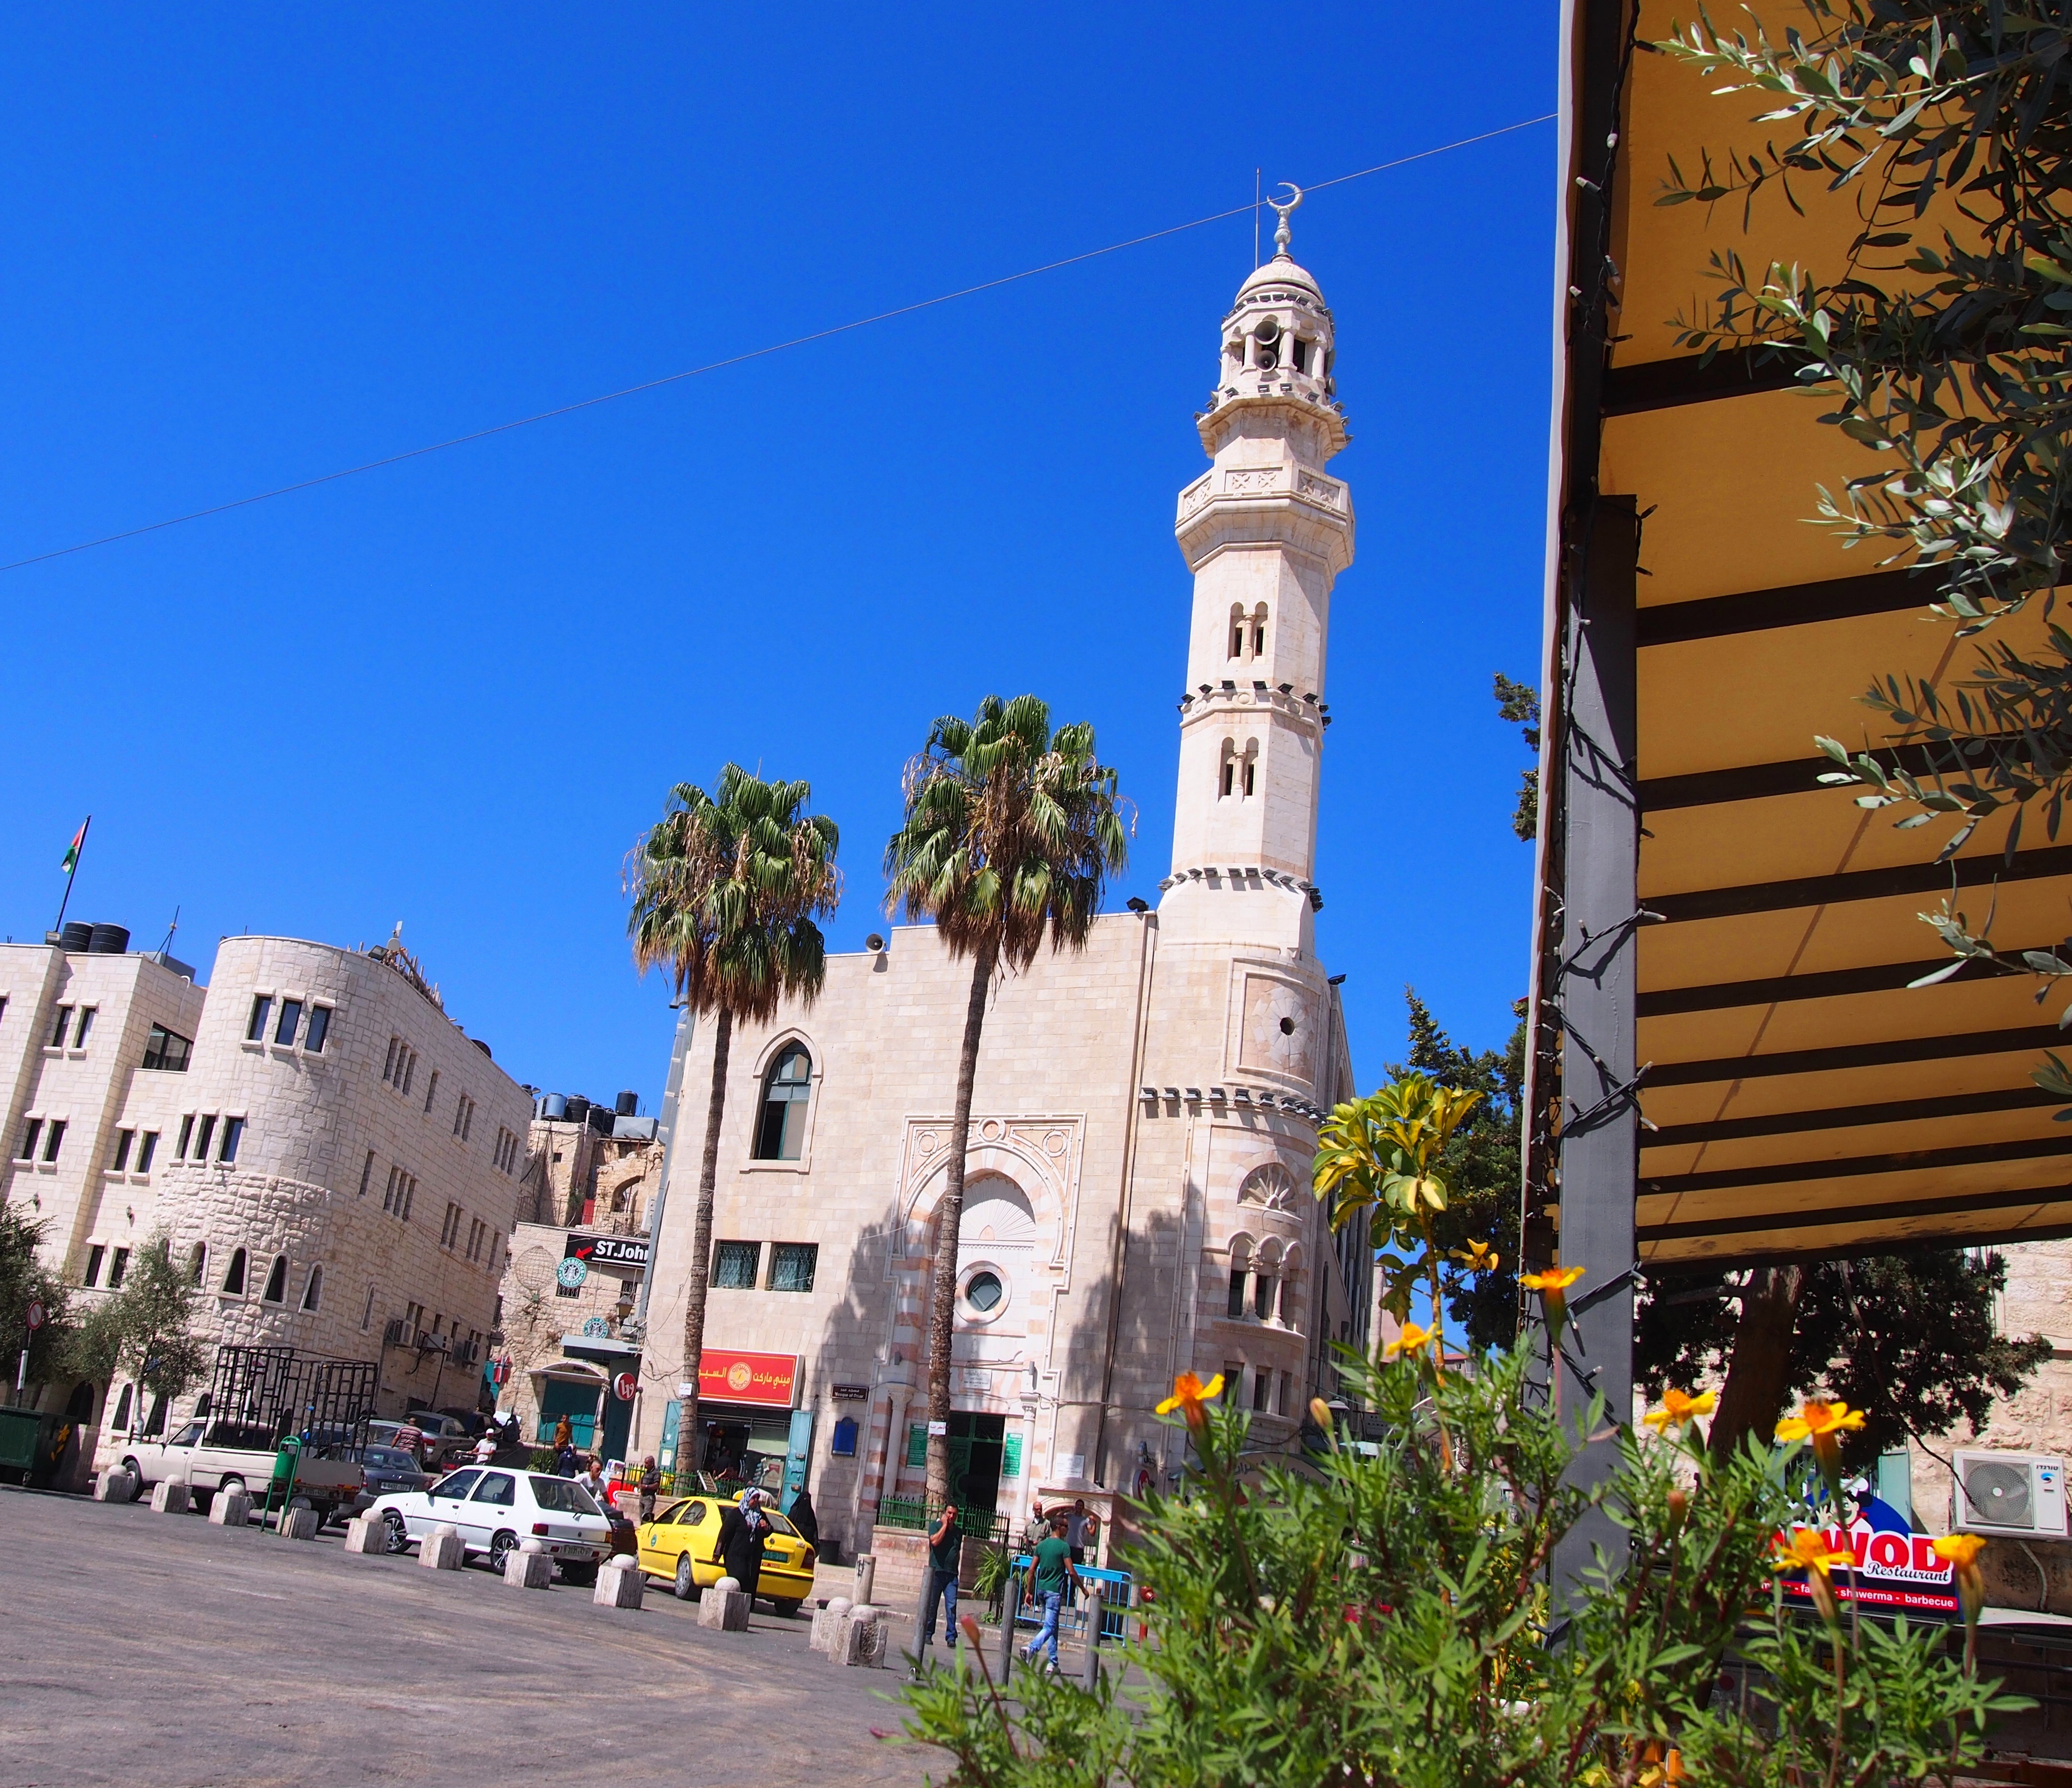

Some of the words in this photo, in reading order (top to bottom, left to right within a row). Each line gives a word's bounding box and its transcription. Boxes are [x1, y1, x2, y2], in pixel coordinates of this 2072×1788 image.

[559, 1259, 585, 1273] STARBUCKS
[752, 1372, 773, 1385] ماركت
[773, 1374, 791, 1389] ميني
[1867, 1562, 1949, 1582] Restaurant
[1904, 1593, 1954, 1607] barbecue
